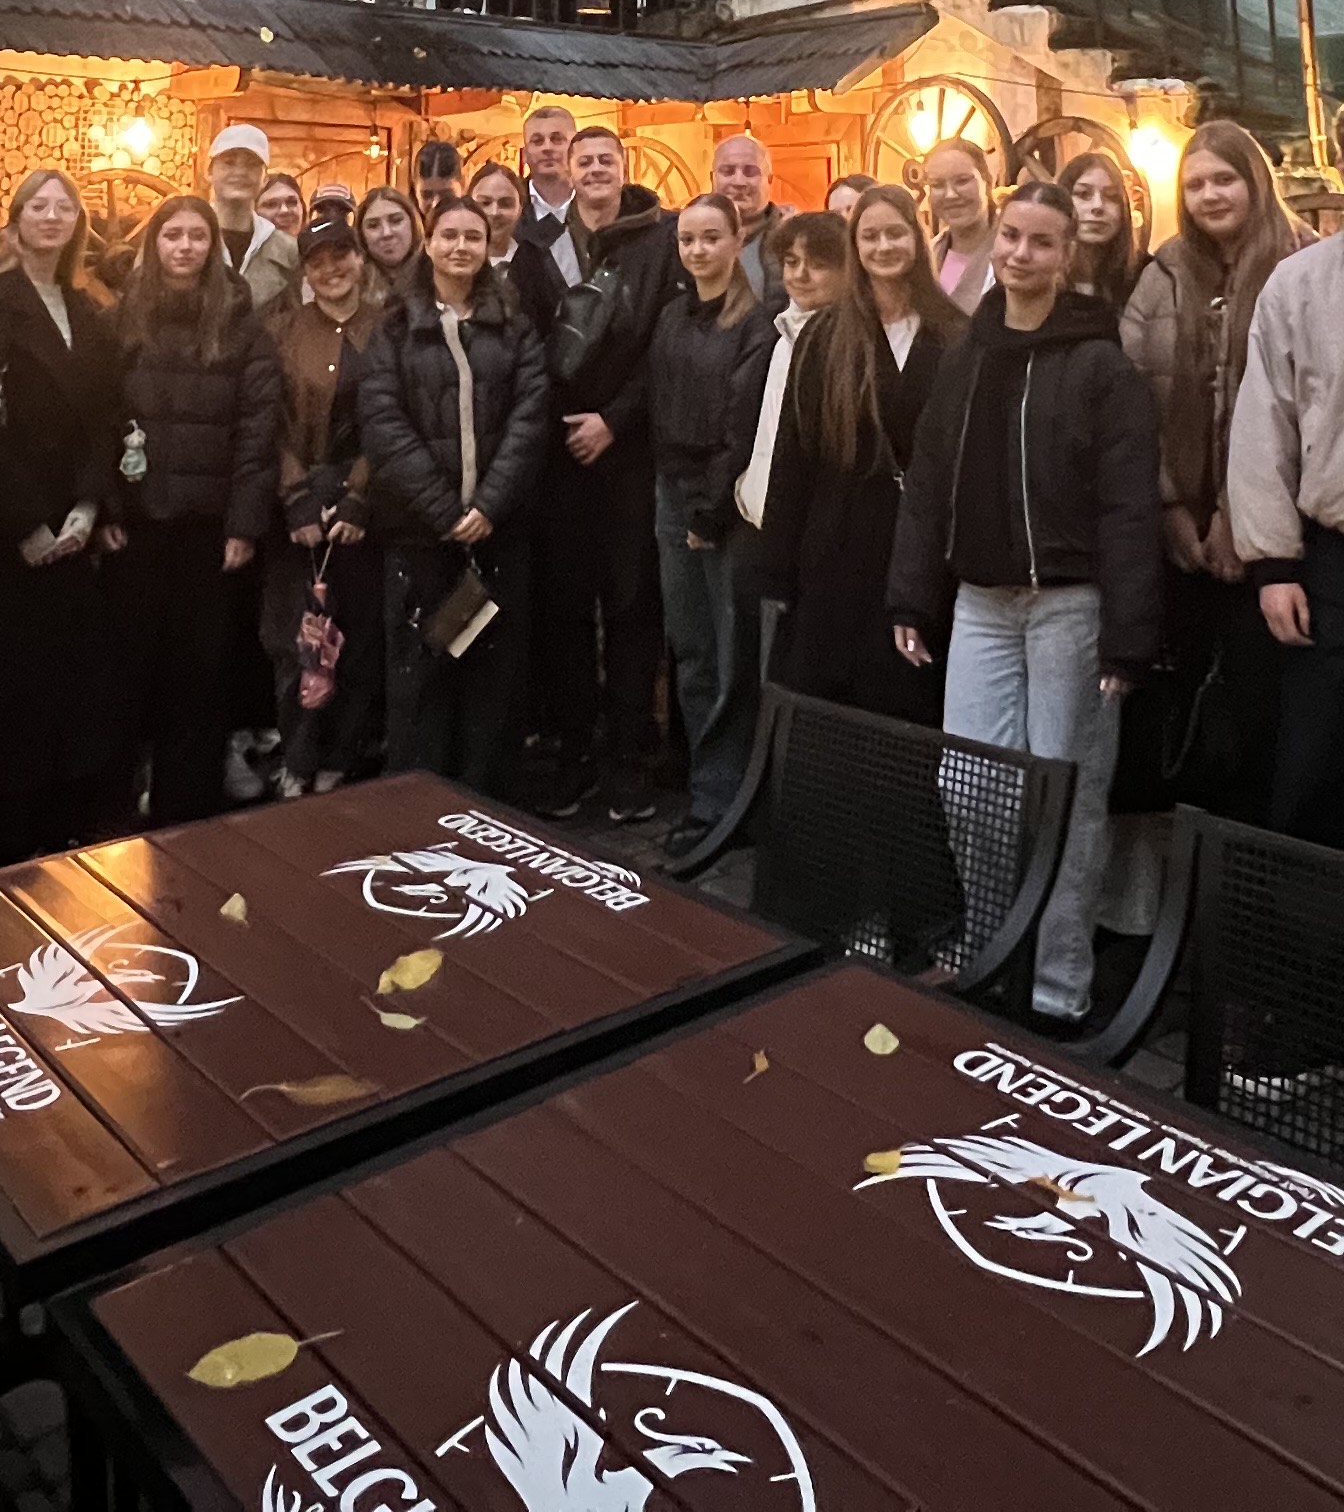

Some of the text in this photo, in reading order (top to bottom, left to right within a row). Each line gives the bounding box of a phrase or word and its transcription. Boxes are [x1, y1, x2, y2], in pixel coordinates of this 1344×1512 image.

[437, 813, 540, 859] LEGEND
[518, 851, 650, 911] BELGIAN
[953, 1050, 1151, 1150] LEGEND
[264, 1383, 437, 1512] BELG
